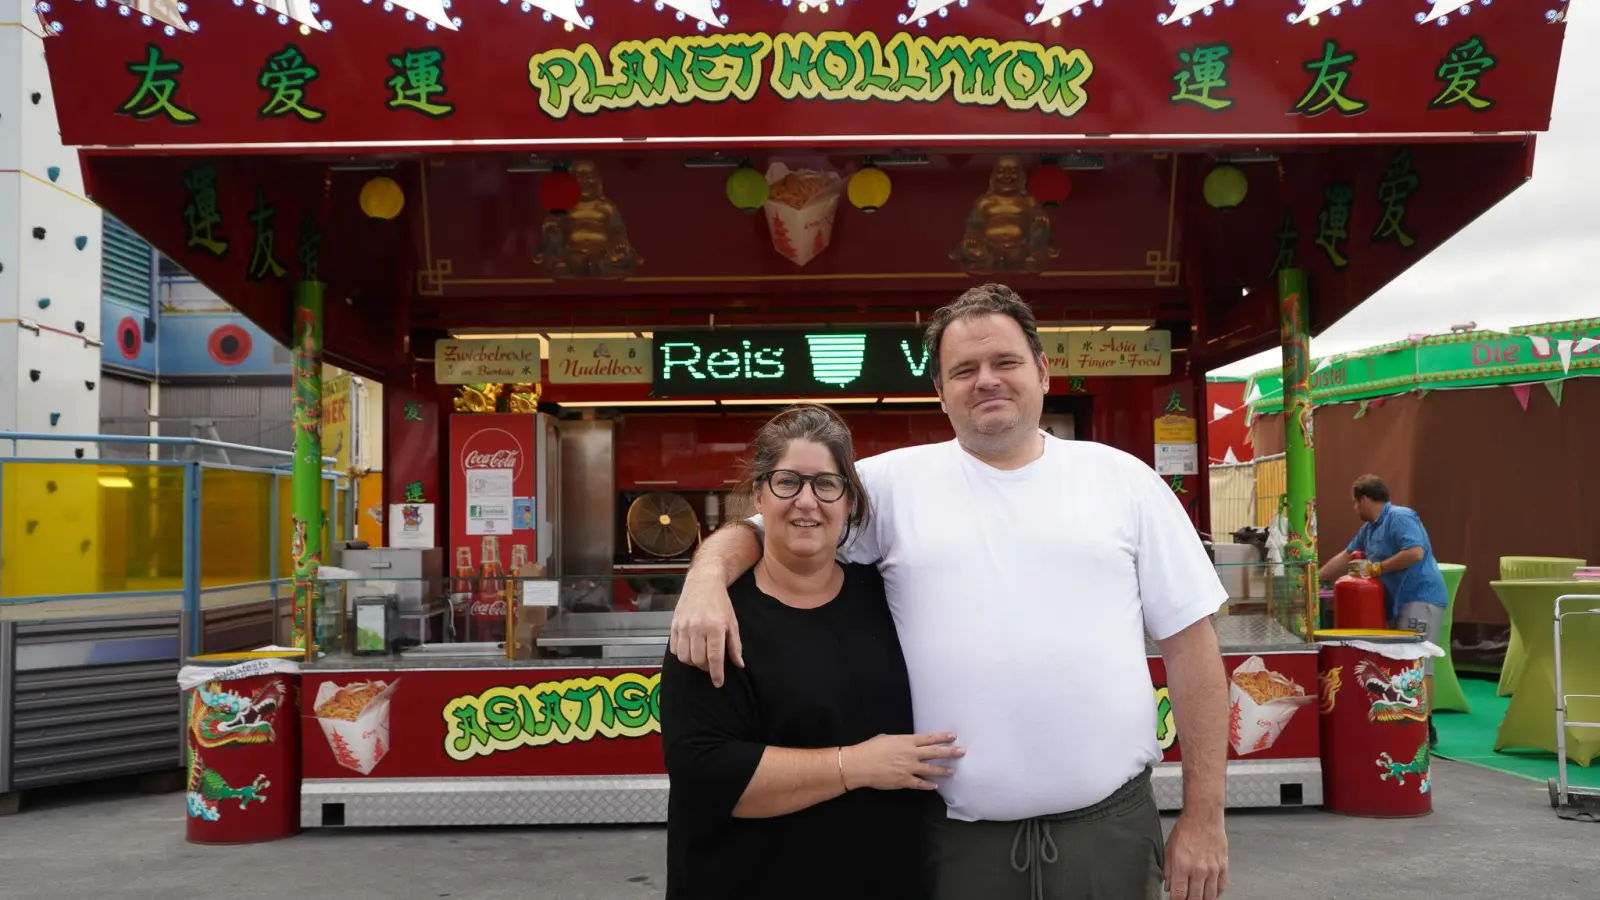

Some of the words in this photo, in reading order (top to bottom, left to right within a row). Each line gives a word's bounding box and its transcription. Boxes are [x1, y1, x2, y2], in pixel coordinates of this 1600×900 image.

[122, 45, 197, 122] 友
[388, 49, 454, 116] 運
[532, 37, 768, 114] PLANET
[775, 36, 1089, 113] HOLLYWOK
[1170, 45, 1234, 110] 運
[1296, 41, 1368, 113] 友
[1100, 337, 1137, 352] Asia
[1471, 342, 1521, 367] Die
[558, 358, 645, 378] Nudelbox
[660, 340, 785, 380] Reis
[1078, 354, 1117, 369] Finger
[1128, 354, 1163, 369] Food
[465, 450, 520, 469] Coca-Cola
